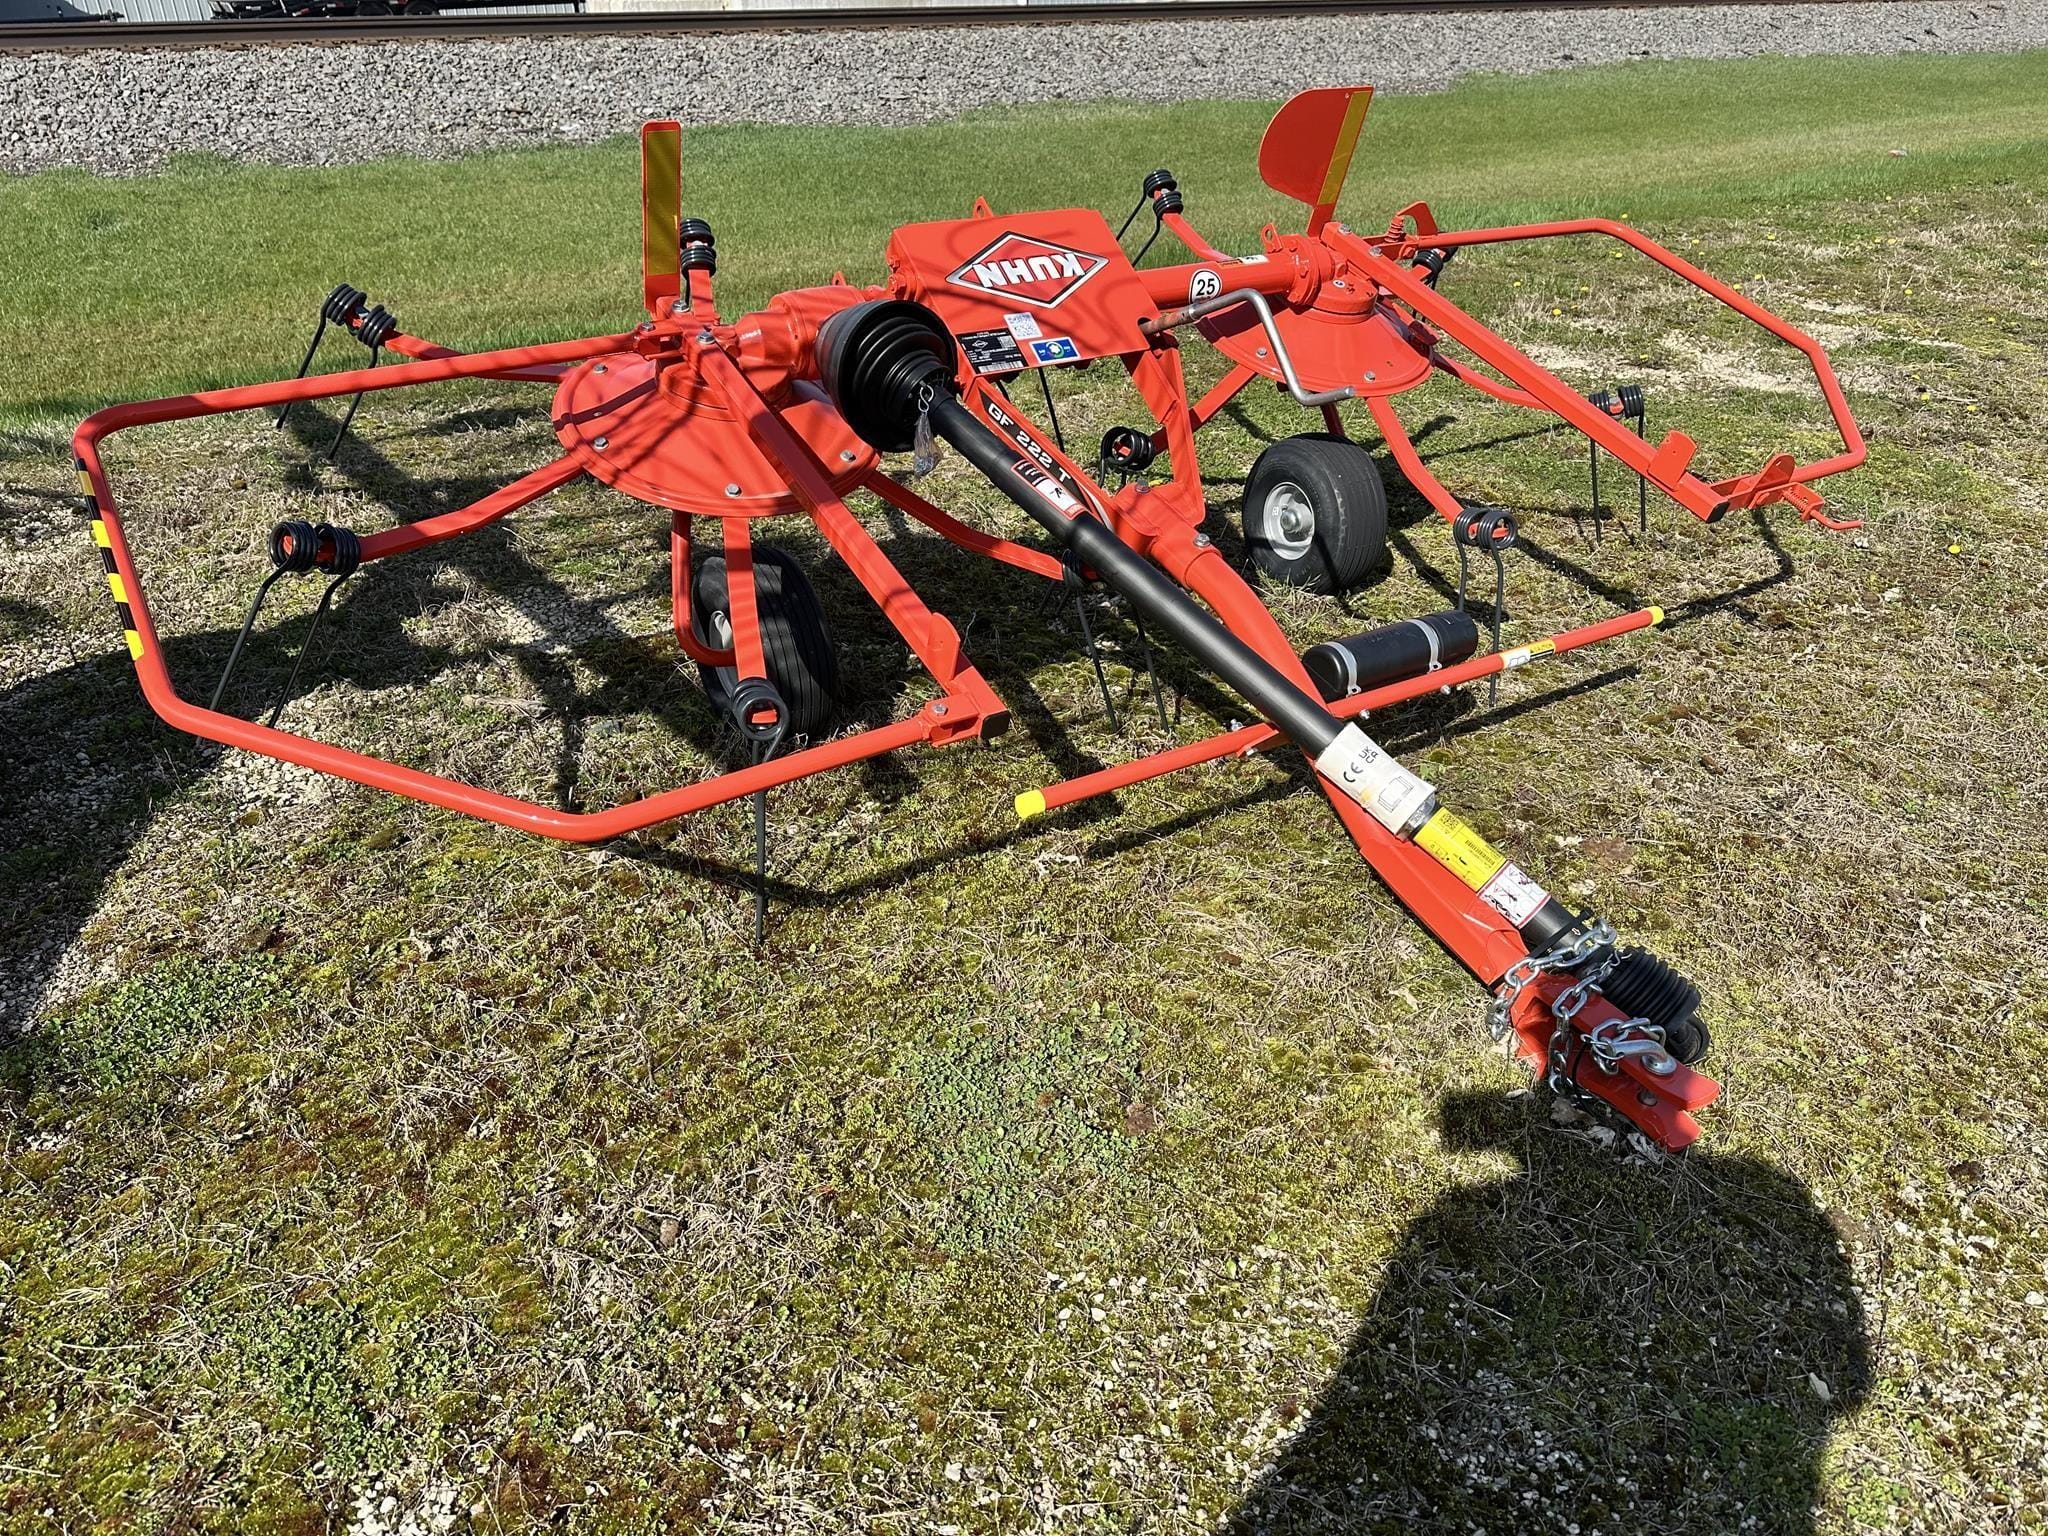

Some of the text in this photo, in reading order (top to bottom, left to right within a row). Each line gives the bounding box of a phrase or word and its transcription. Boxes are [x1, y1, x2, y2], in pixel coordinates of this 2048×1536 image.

[973, 252, 1086, 288] KUHN
[1196, 278, 1216, 296] 25
[988, 403, 1014, 426] GF
[1016, 430, 1053, 469] 222
[1059, 467, 1072, 482] T
[1343, 762, 1364, 783] CE
